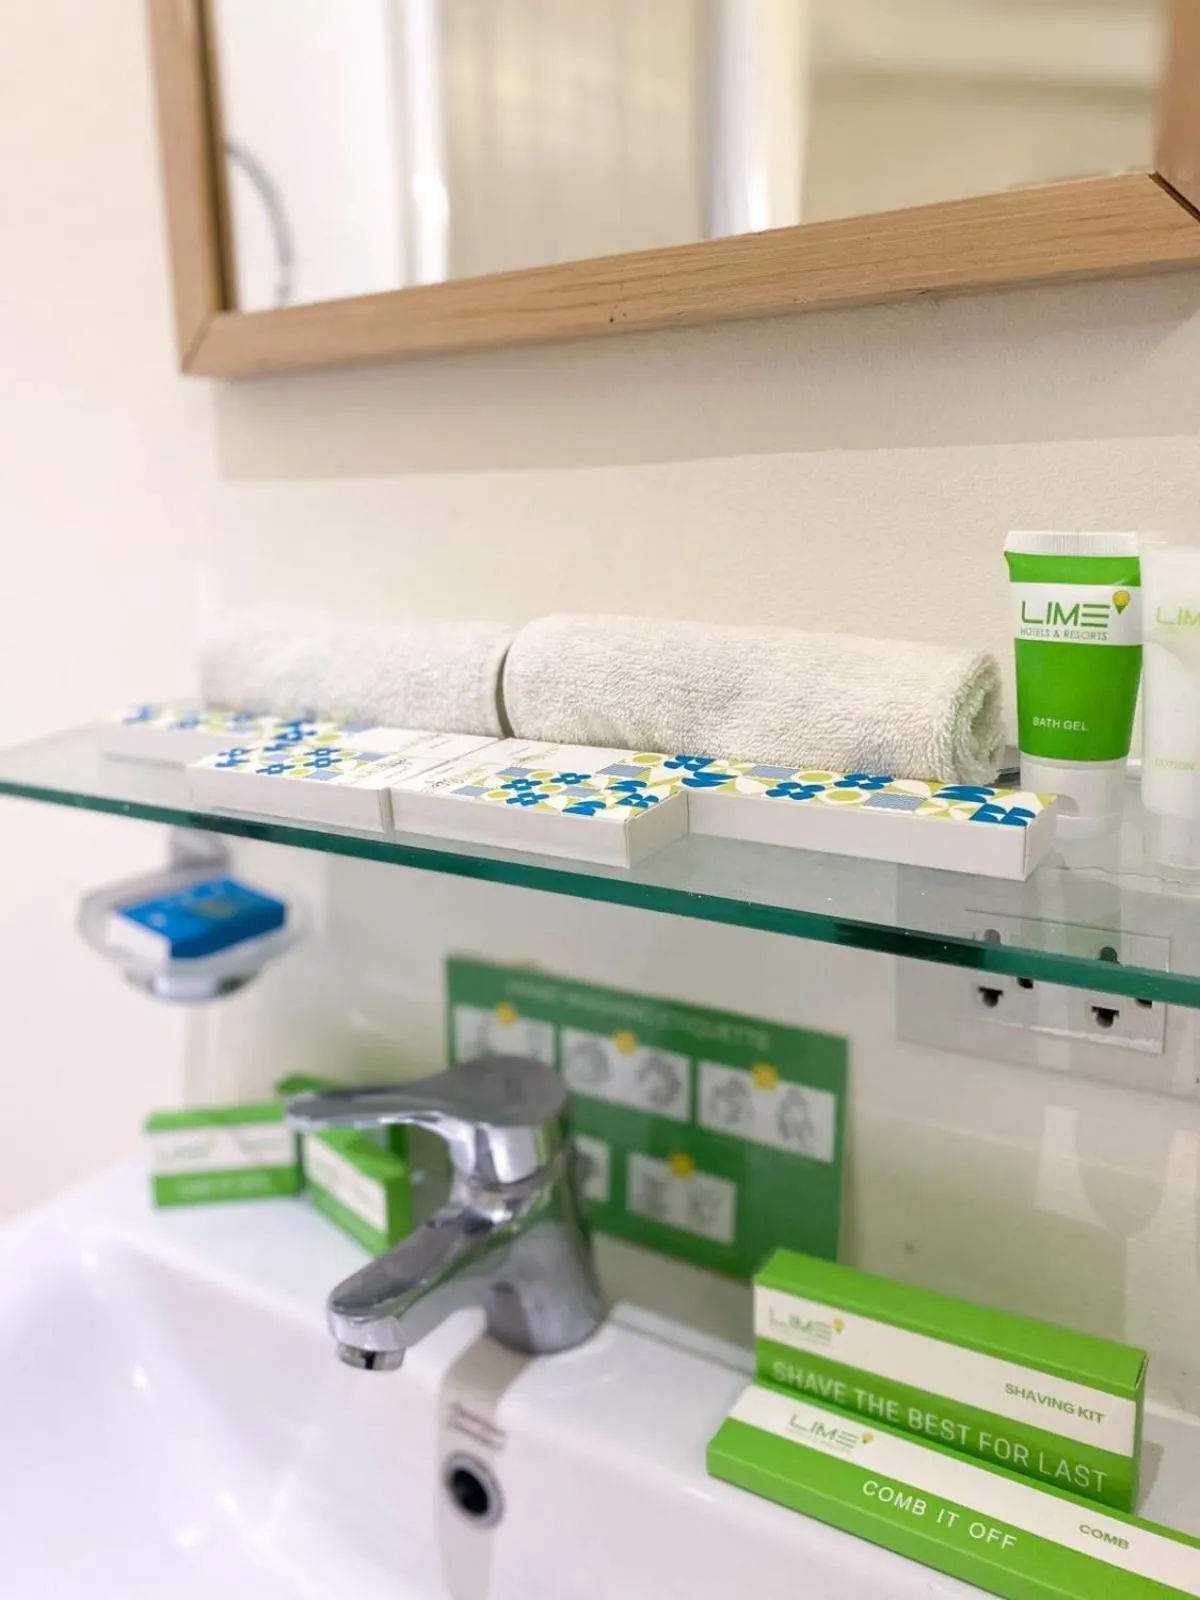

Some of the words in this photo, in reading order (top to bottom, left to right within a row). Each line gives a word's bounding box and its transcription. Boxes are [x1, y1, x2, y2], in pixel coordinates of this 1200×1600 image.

[1021, 599, 1111, 629] LIME
[1033, 716, 1061, 729] BATH
[1063, 720, 1089, 732] GEL
[1004, 1382, 1075, 1414] SHAVING
[1077, 1405, 1105, 1424] KIT
[771, 1360, 848, 1405] SHAVE
[852, 1387, 900, 1424] THE
[907, 1407, 971, 1446] BEST
[978, 1431, 1029, 1468] FOR
[1039, 1451, 1109, 1494] LAST
[789, 1413, 860, 1449] LIME
[862, 1479, 928, 1517] COMB
[935, 1508, 961, 1529] IT
[968, 1521, 1018, 1550] OFF
[1079, 1524, 1130, 1550] COMB
